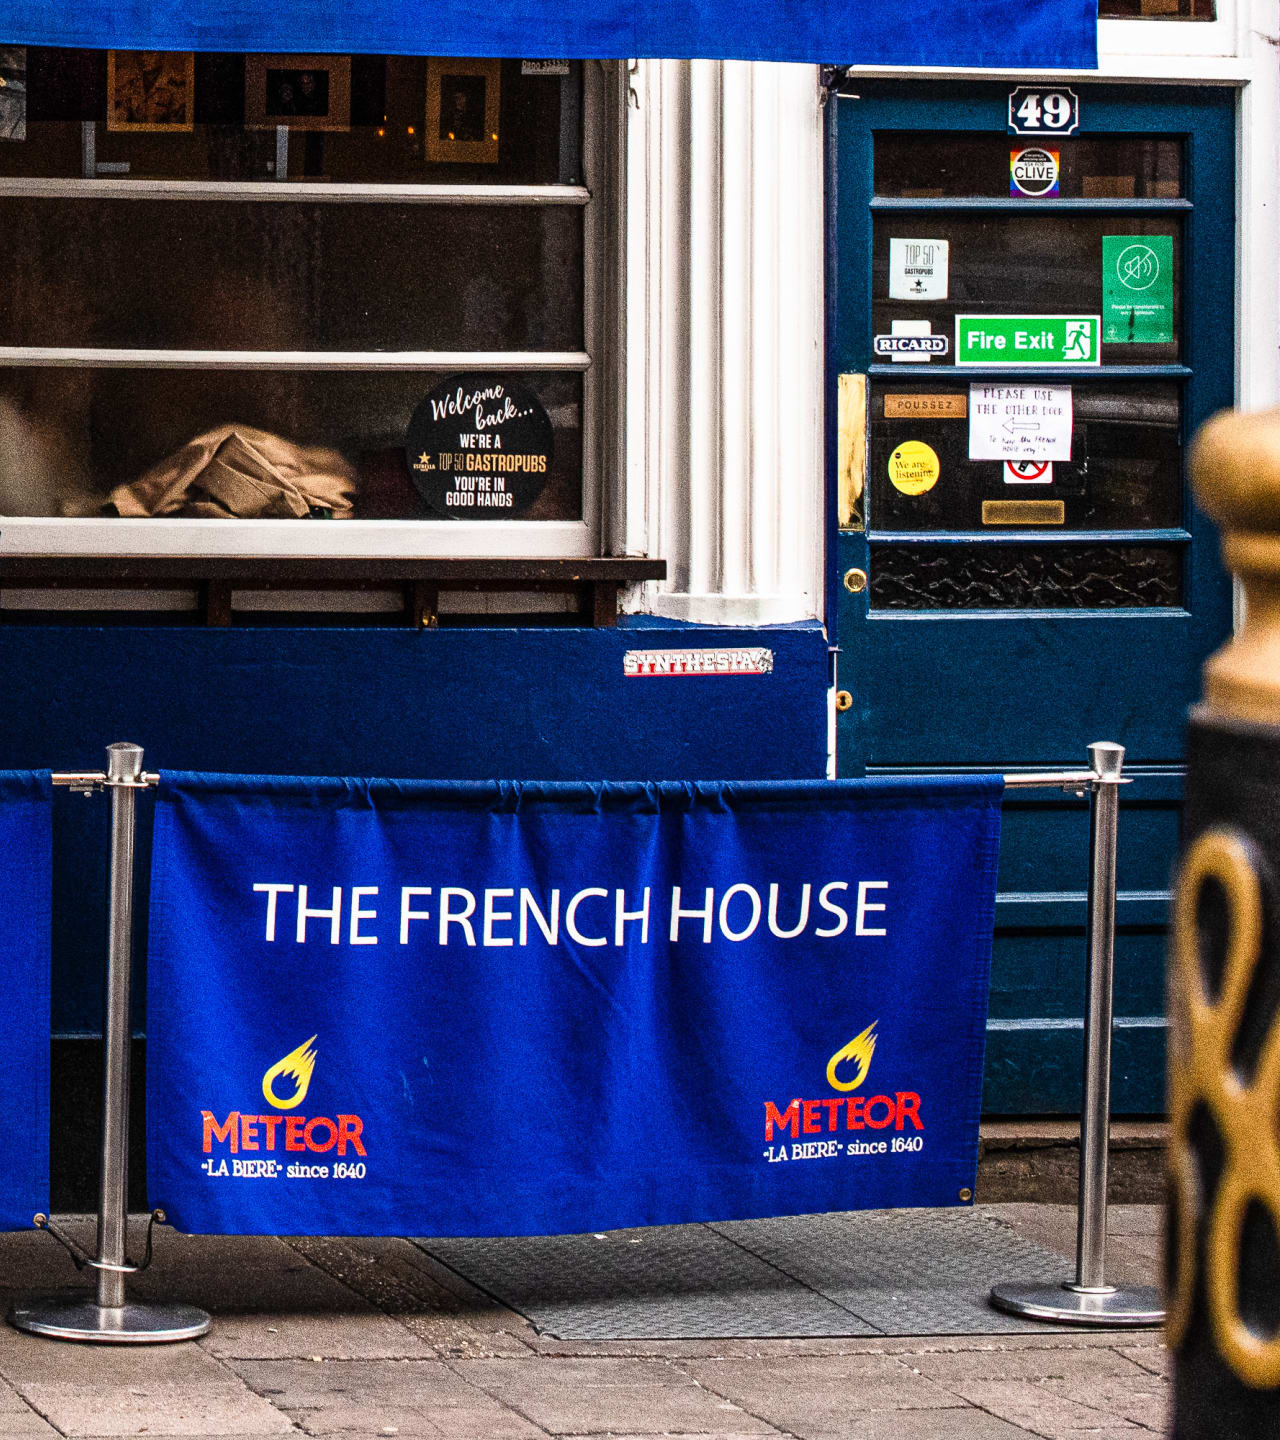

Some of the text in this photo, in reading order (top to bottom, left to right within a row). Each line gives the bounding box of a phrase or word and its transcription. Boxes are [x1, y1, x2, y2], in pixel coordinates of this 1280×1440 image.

[1016, 93, 1072, 128] 49
[1014, 166, 1054, 179] CLIVE
[905, 245, 934, 266] TOP 50
[879, 339, 945, 352] RICARD
[967, 331, 1055, 349] Fire Exit
[431, 384, 504, 421] Welcome
[983, 388, 1053, 401] PLEASE USE
[897, 400, 952, 409] POUSSEZ
[977, 403, 998, 415] THE
[1005, 404, 1038, 416] OTHER
[459, 433, 501, 449] WE'RE A
[439, 453, 547, 473] TOP 50 GASTROPUBS
[895, 461, 909, 469] We
[454, 476, 505, 491] YOU'RE IN
[445, 492, 513, 507] GOOD HANDS
[624, 652, 757, 674] SYNTHESIA
[252, 880, 891, 949] THE FRENCH HOUSE
[763, 1091, 925, 1142] METEOR
[200, 1110, 368, 1157] METEOR
[846, 1139, 887, 1156] since
[890, 1136, 924, 1153] 1640
[286, 1162, 329, 1178] since
[332, 1163, 367, 1179] 1640
